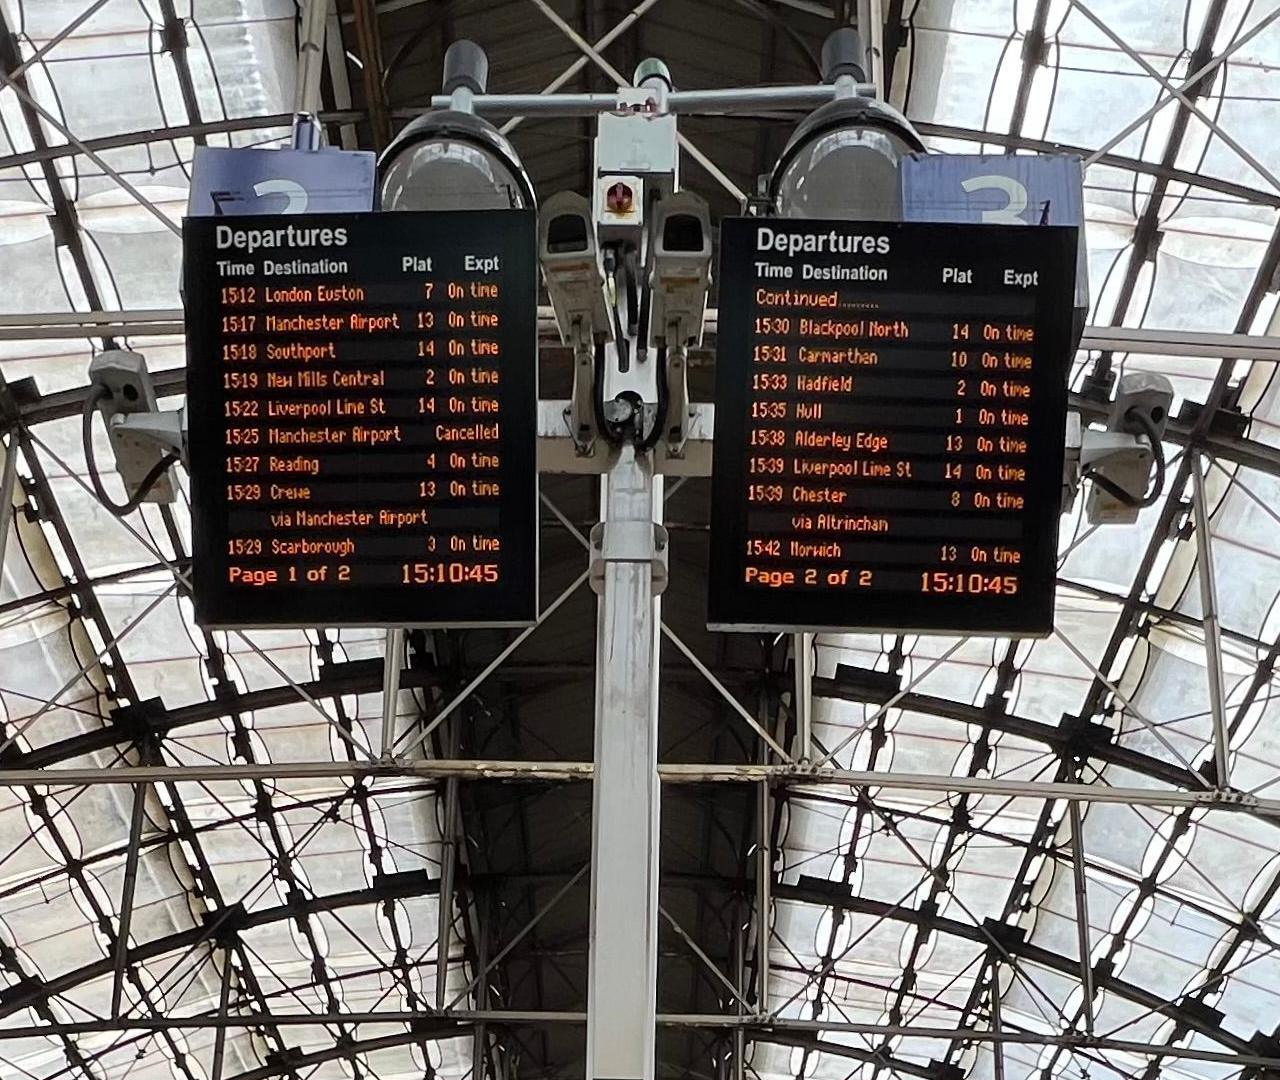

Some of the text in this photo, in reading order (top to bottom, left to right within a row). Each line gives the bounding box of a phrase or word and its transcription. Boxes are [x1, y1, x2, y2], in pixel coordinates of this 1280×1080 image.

[216, 225, 348, 254] Departures
[757, 227, 890, 257] Departures
[216, 255, 500, 276] Time Destination Plat Expt
[754, 262, 1038, 288] Time Destination Plat Expt
[265, 286, 312, 303] London
[317, 285, 364, 302] Euston
[425, 282, 434, 300] 7
[448, 282, 464, 299] On
[470, 282, 498, 298] time
[222, 310, 499, 333] 15:17 Manchester Airport 13 On time
[755, 317, 1034, 341] 15:30 Blackpool North 14 On time
[223, 338, 499, 362] 15:18 Southport 14 On time
[753, 345, 1032, 369] 15:31 Carmarthen 10 On time
[223, 368, 499, 389] 15:19 New Mills Central 2 On time
[752, 373, 1031, 398] 15:33 Hadfield 2 On time
[224, 400, 259, 417] 15:22
[268, 400, 331, 419] Liverpool
[370, 397, 386, 414] St
[419, 397, 435, 413] 14
[449, 396, 465, 413] On
[471, 396, 499, 413] time
[751, 401, 1029, 426] 15:35 Hull 1 On time
[225, 422, 499, 446] 15:25 Manchester Airport Cancelled
[750, 429, 1027, 453] 15:38 Alderley Edge 13 On time
[226, 452, 499, 475] 15:27 Reading 4 On time
[750, 457, 784, 474] 15:39
[793, 458, 858, 479] Liverpool
[896, 461, 912, 478] St
[944, 463, 962, 479] 14
[975, 464, 992, 480] On
[998, 465, 1026, 481] time
[227, 480, 500, 501] 15:29 Crewe 13 On time
[748, 484, 1024, 509] 15:39 Chester 8 On time
[271, 509, 428, 528] via Manchester Airport
[791, 513, 813, 530] via
[228, 535, 500, 557] 15:29 Scarborough 3 On time
[746, 539, 1021, 564] 15:42 Norwich 13 On time
[229, 562, 499, 586] Page 1 of 2 15:10:45
[745, 566, 1018, 595] Page 2 of 2 15:10:45
